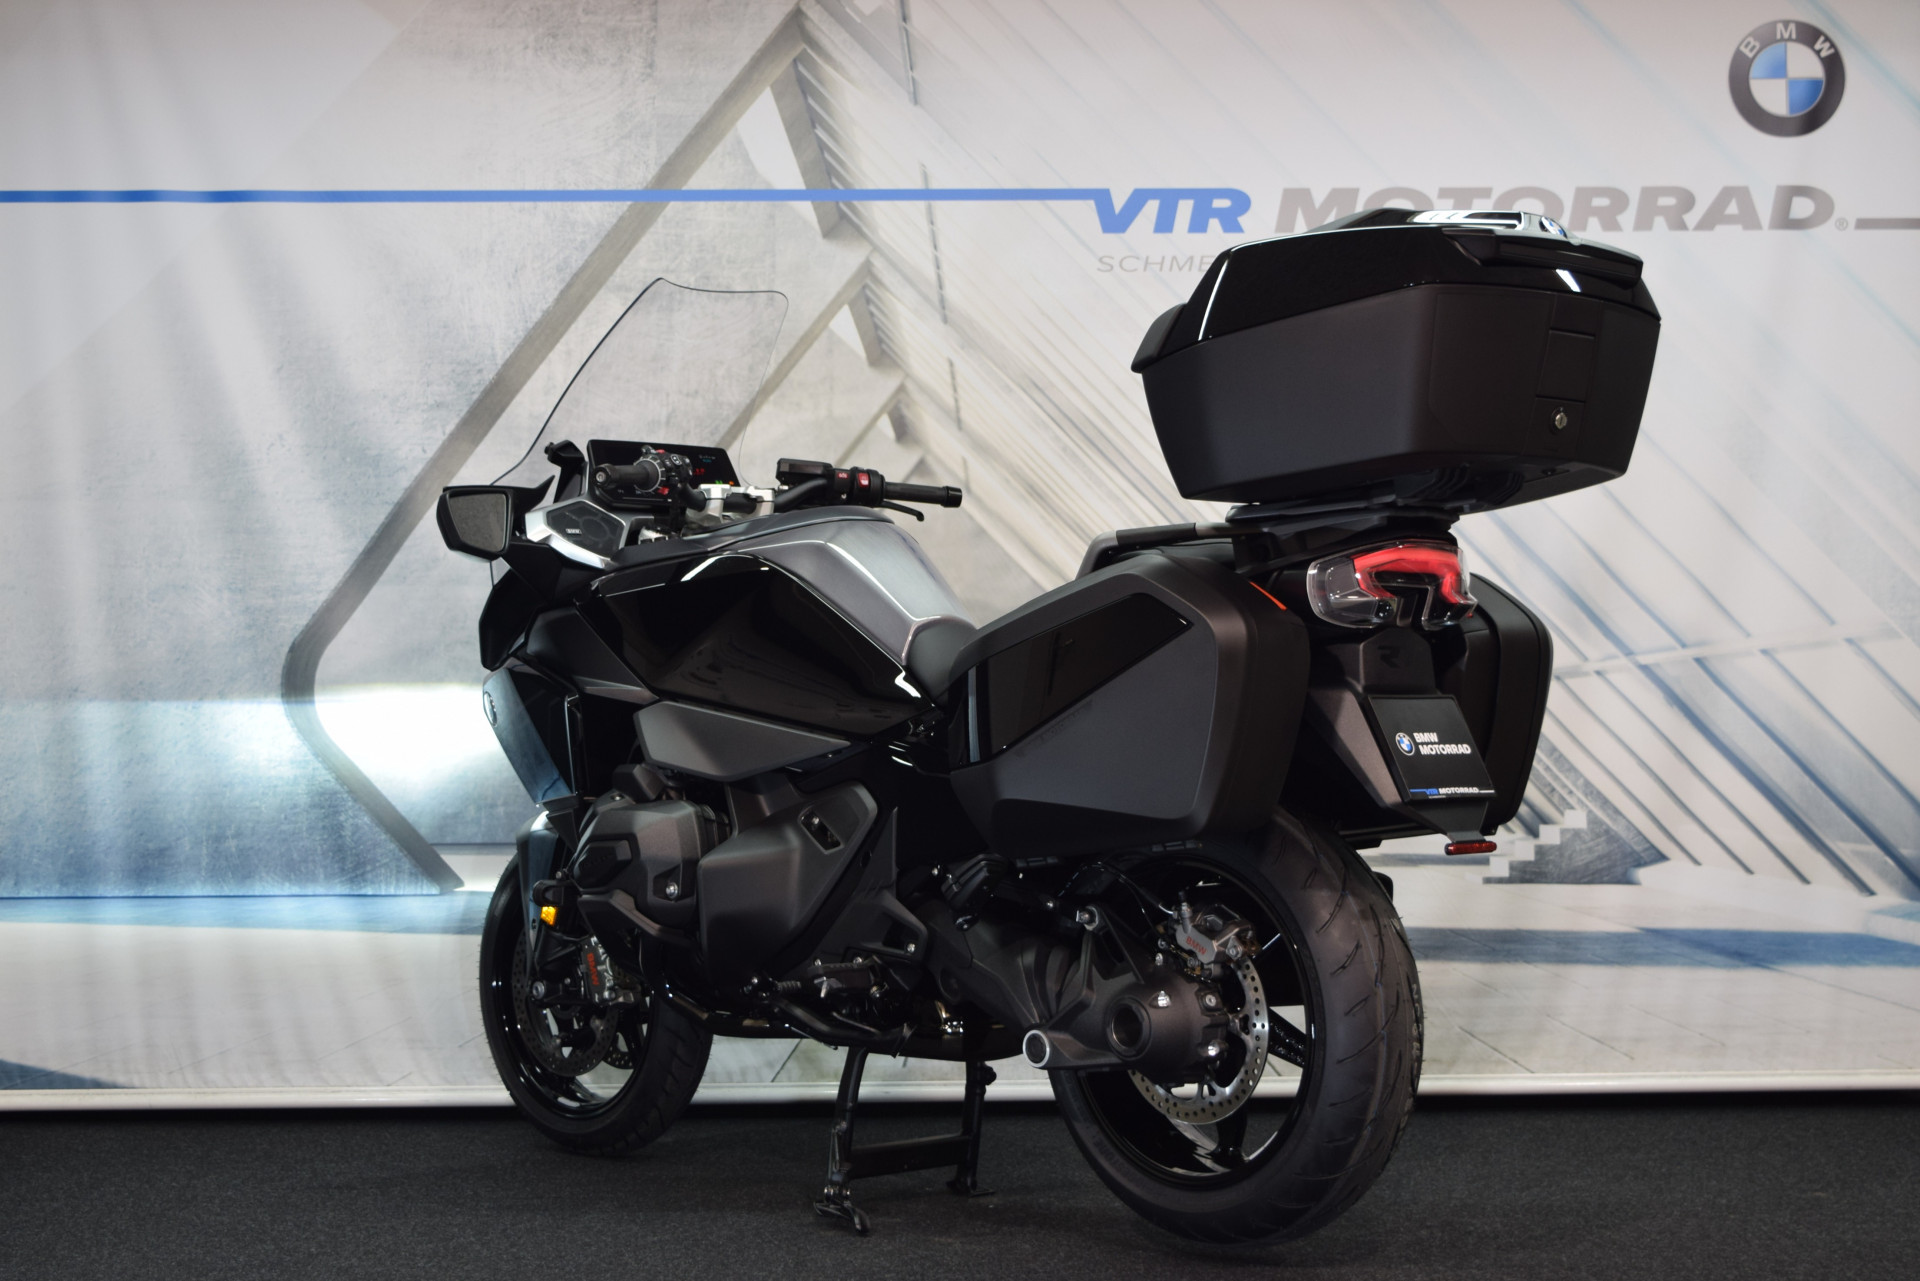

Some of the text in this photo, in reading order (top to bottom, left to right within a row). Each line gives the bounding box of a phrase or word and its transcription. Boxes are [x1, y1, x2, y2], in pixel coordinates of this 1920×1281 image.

[1739, 22, 1835, 58] BMW
[1091, 188, 1252, 234] VTR
[1413, 732, 1438, 742] BMW
[1419, 744, 1471, 754] MOTORRAD
[1438, 787, 1480, 795] MOTORRAD
[1186, 936, 1207, 955] BMW
[587, 952, 600, 986] BMW
